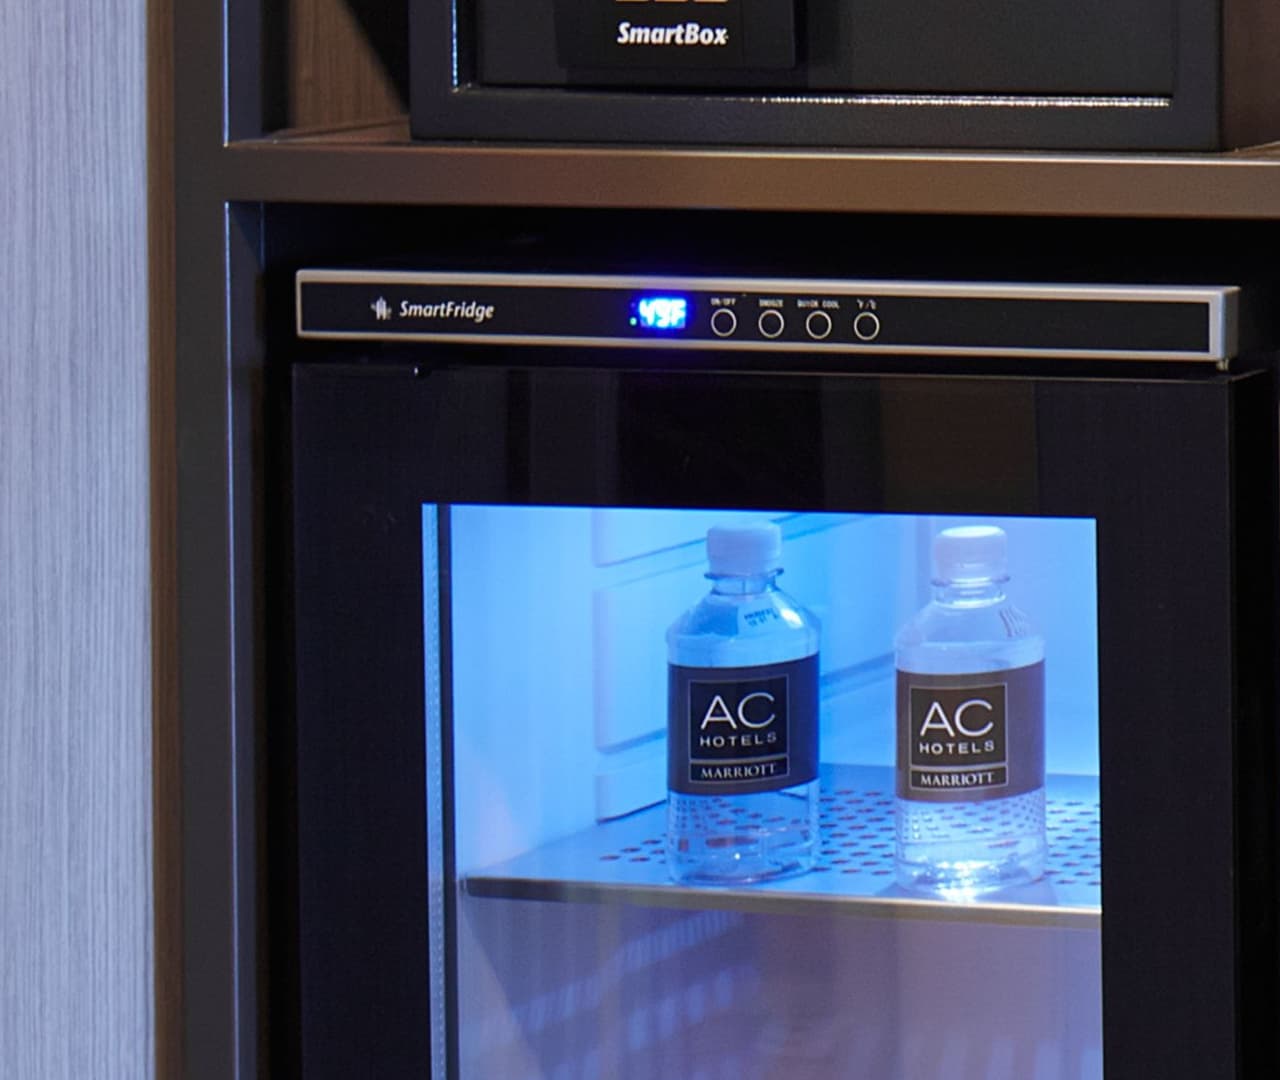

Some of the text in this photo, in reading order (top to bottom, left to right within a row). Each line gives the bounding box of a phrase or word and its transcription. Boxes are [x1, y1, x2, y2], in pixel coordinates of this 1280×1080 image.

[617, 21, 728, 45] SmartBox
[399, 300, 495, 323] SmartFridge
[700, 692, 776, 730] AC
[920, 699, 994, 737] AC
[700, 732, 777, 748] HOTELS
[919, 740, 994, 755] HOTELS
[701, 763, 776, 779] MARRIOTT
[920, 772, 995, 786] MARRIOTT
